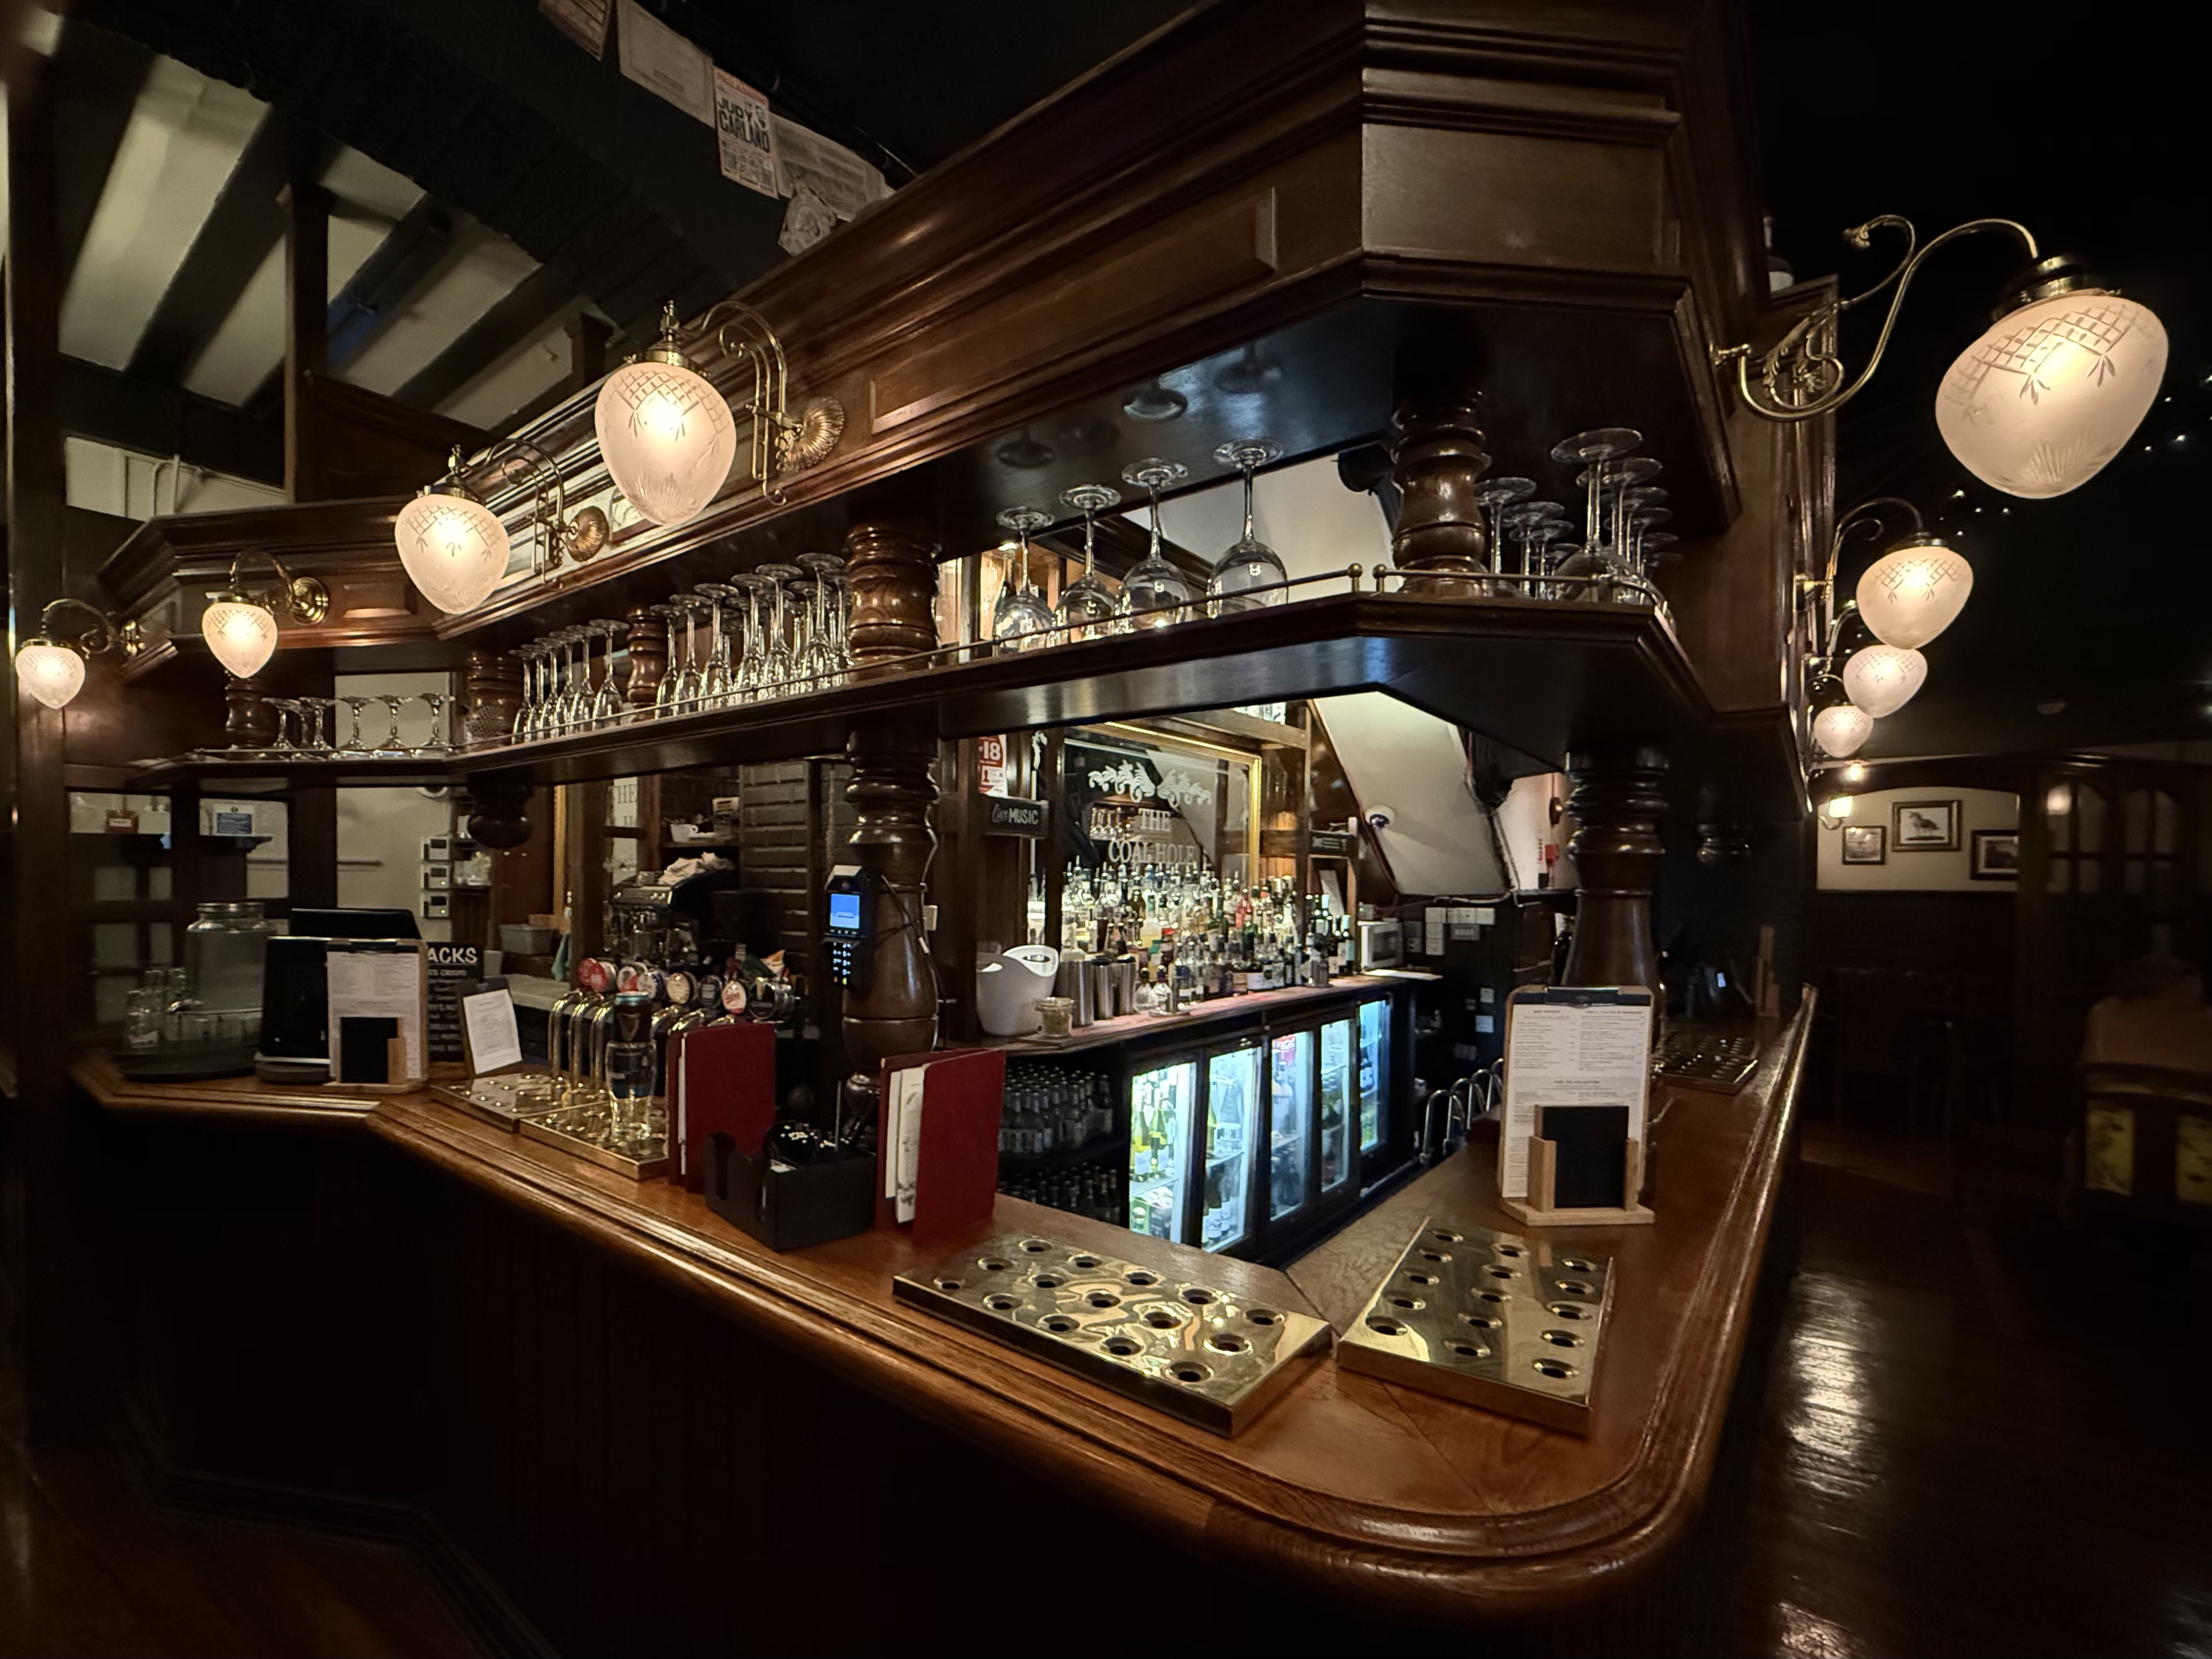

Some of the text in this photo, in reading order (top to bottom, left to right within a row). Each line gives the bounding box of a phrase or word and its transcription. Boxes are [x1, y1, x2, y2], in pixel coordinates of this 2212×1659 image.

[717, 98, 753, 120] JUDY
[719, 110, 770, 152] GARLAND
[983, 741, 1002, 761] 18
[1008, 808, 1039, 825] MUSIC
[1138, 808, 1171, 831] THE
[1108, 840, 1195, 865] COAL HOLE
[428, 946, 478, 964] ACKS
